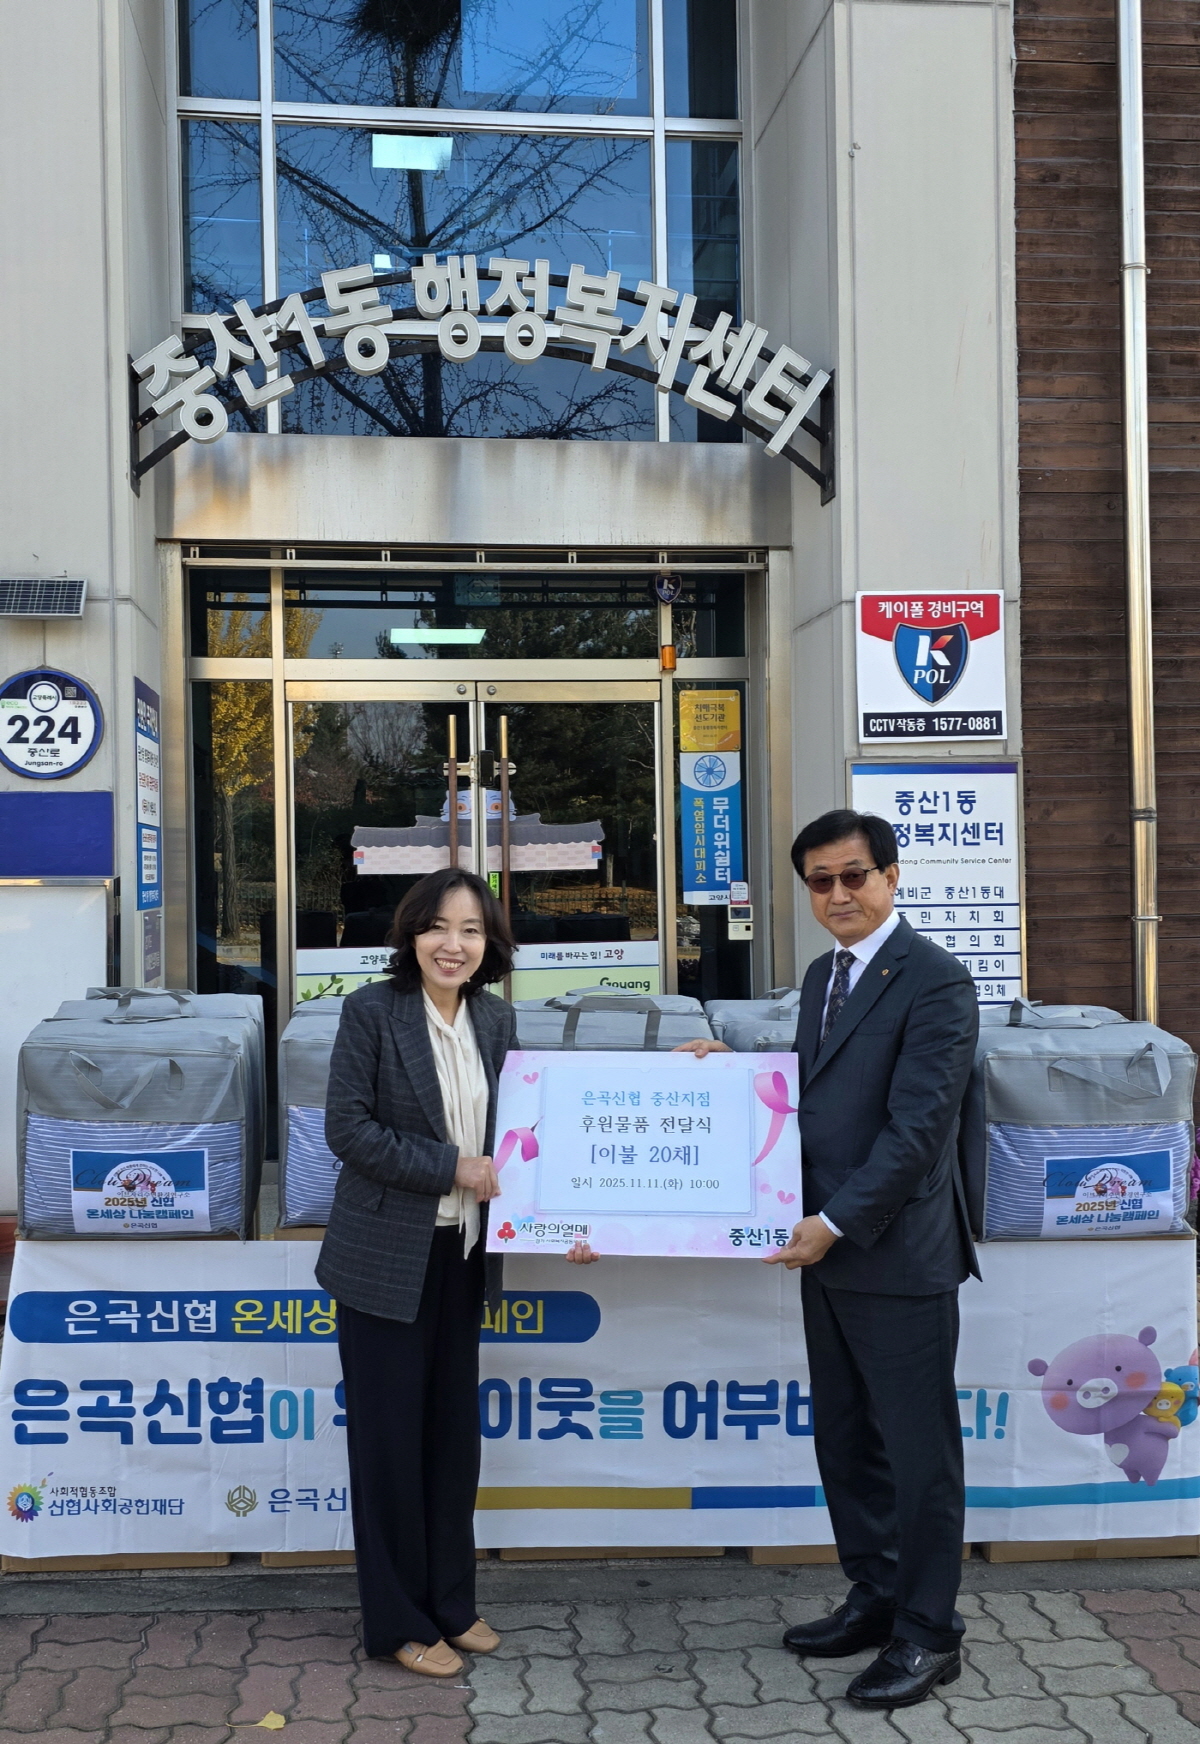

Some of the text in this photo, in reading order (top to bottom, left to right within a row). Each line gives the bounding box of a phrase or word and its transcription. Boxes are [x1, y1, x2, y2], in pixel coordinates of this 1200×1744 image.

[132, 253, 831, 457] 중산1동 행정복지센터
[877, 600, 985, 619] 케이폴 경비구역
[915, 634, 954, 666] K
[913, 669, 951, 684] POL
[694, 703, 726, 712] 치매극복
[694, 714, 726, 722] 선도기관
[869, 716, 998, 732] CCTV작동중 1577-0881
[7, 714, 82, 744] 224
[27, 747, 61, 757] 중산로
[24, 760, 64, 768] Jungsan-ro
[895, 790, 977, 816] 중산1동
[693, 797, 707, 884] 폭염임시대피소
[712, 797, 731, 884] 무더위쉼터
[893, 822, 1004, 848] 정복지센터
[899, 857, 1013, 866] dong Community Service Center
[894, 886, 1005, 900] 예비군 중산1동대
[360, 954, 389, 965] 고양특
[540, 948, 625, 961] 미래를 바꾸는 힘! 고양
[962, 959, 1005, 972] 지킴이
[600, 977, 650, 991] Goyang
[975, 984, 1006, 997] 협의체
[581, 1090, 710, 1107] 은곡신협 중산지점
[579, 1115, 712, 1134] 후원물품 전달식
[591, 1144, 699, 1166] [이불 20채]
[571, 1176, 720, 1190] 일시 2025.11.11.(화) 10:00
[104, 1197, 175, 1207] 2025년 신협
[1075, 1198, 1143, 1212] 2025년 신협
[86, 1209, 194, 1219] 온세상 나눔캠페인
[1056, 1210, 1160, 1226] 온세상 나눔캠페인
[519, 1222, 588, 1238] 사랑의열매
[729, 1228, 789, 1246] 중산1동
[64, 1298, 544, 1335] 은곡신협 온세상 페인
[12, 1377, 315, 1446] 은곡신협이
[480, 1376, 644, 1441] 이웃을
[956, 1388, 1009, 1440] 다!
[50, 1486, 117, 1497] 사회적협동조합
[48, 1498, 185, 1516] 신협사회공헌재단
[267, 1486, 350, 1514] 은곡신
